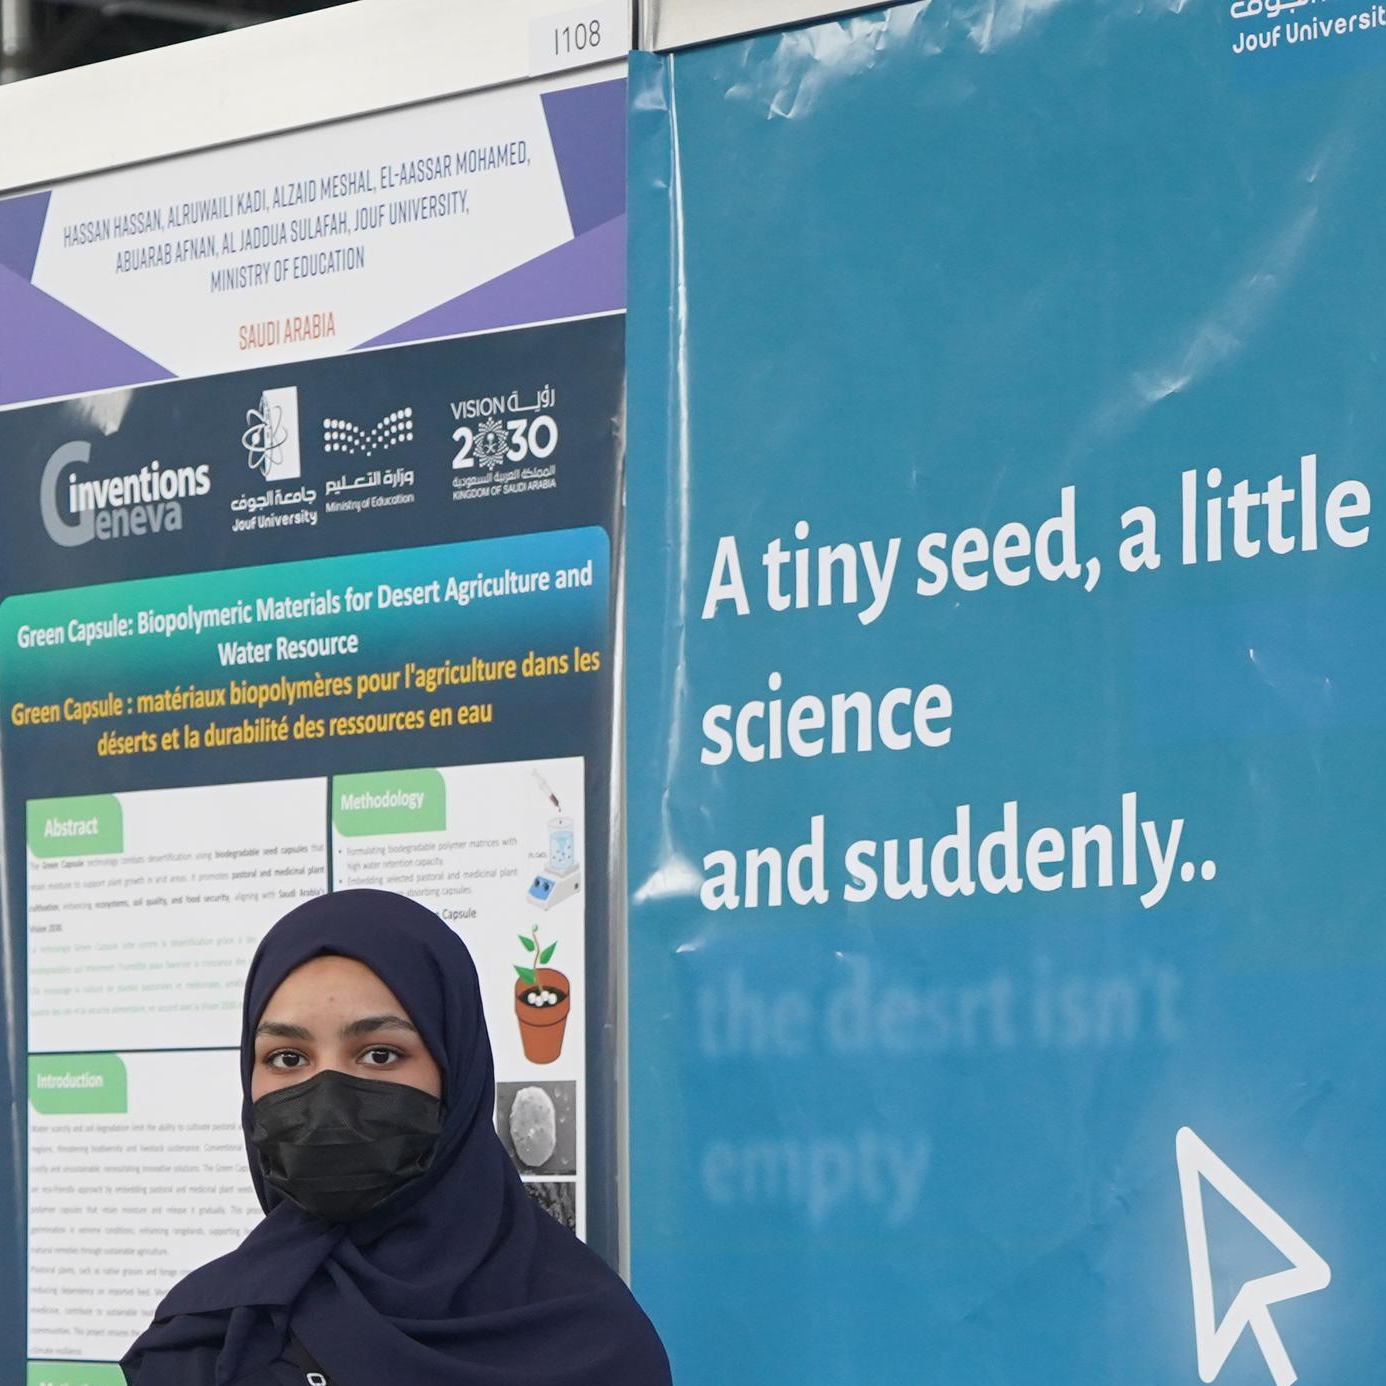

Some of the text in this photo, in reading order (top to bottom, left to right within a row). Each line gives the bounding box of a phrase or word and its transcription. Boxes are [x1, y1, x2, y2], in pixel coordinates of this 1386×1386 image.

[552, 19, 602, 56] I108
[1232, 25, 1281, 54] Jouf
[63, 140, 531, 248] HASSAN HASSAN, ALRUWAILI KADI, ALZAID MESHAL, EL-AASSAR MOHAMED,
[115, 189, 470, 273] ABUARAB AFNAN, AL JADDUA SULAFAH, JOUF UNIVERSITY,
[210, 245, 365, 293] MINISTRY OF EDUCATION
[238, 311, 336, 351] SAUDI ARABIA
[450, 395, 506, 420] VISION
[68, 463, 211, 513] inventions
[231, 508, 318, 532] Jouf University
[701, 453, 1371, 623] A tiny seed, a little
[17, 559, 593, 649] Green Capsule: Biopolymeric Materials for Desert Agriculture and
[217, 634, 359, 667] Water Resource
[700, 677, 953, 766] science
[340, 789, 425, 811] Methodology
[43, 816, 99, 838] Abstract
[697, 791, 1217, 911] and suddenly..
[441, 906, 478, 923] Capsule
[695, 971, 806, 1061] the
[36, 1071, 104, 1089] Introduction
[699, 1128, 930, 1227] empty
